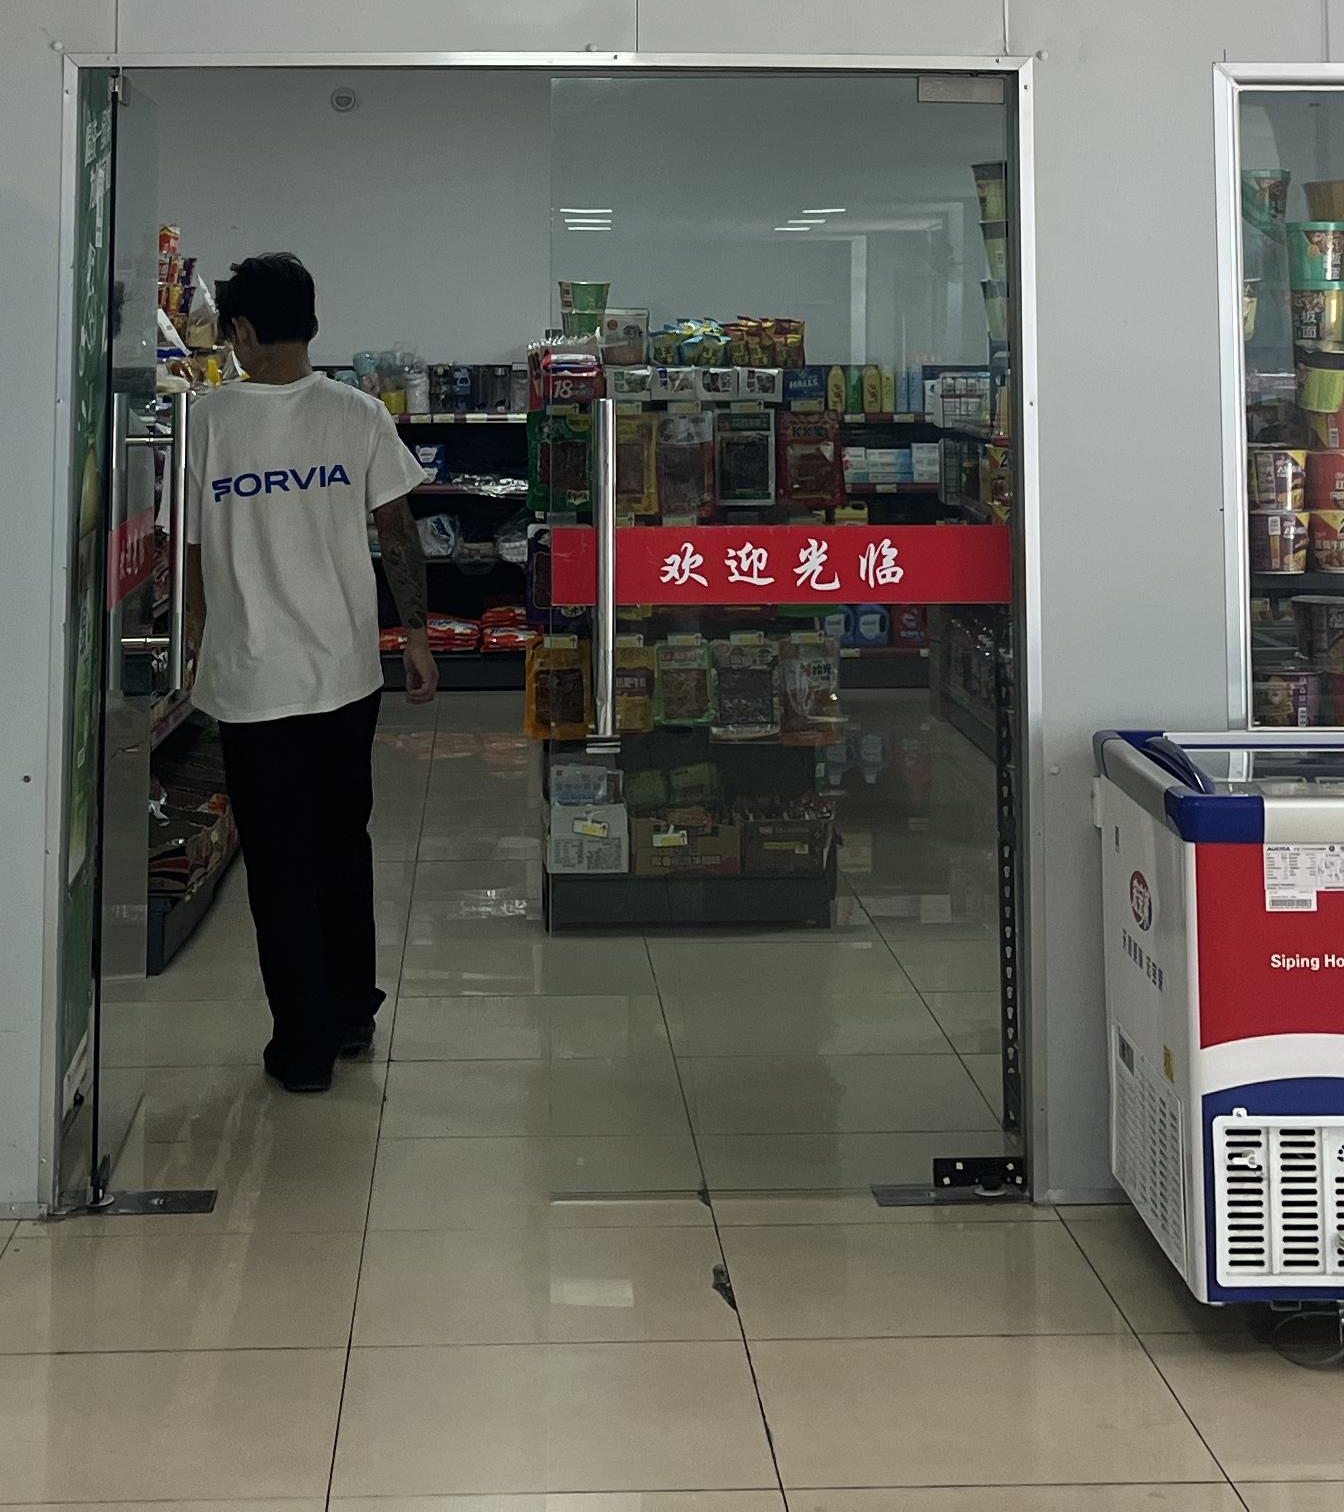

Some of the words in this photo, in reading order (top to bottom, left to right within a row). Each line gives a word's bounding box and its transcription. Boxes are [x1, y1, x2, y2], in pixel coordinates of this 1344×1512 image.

[212, 464, 351, 502] FORVIA
[659, 538, 905, 591] 欢迎光临
[1271, 953, 1320, 971] Siping
